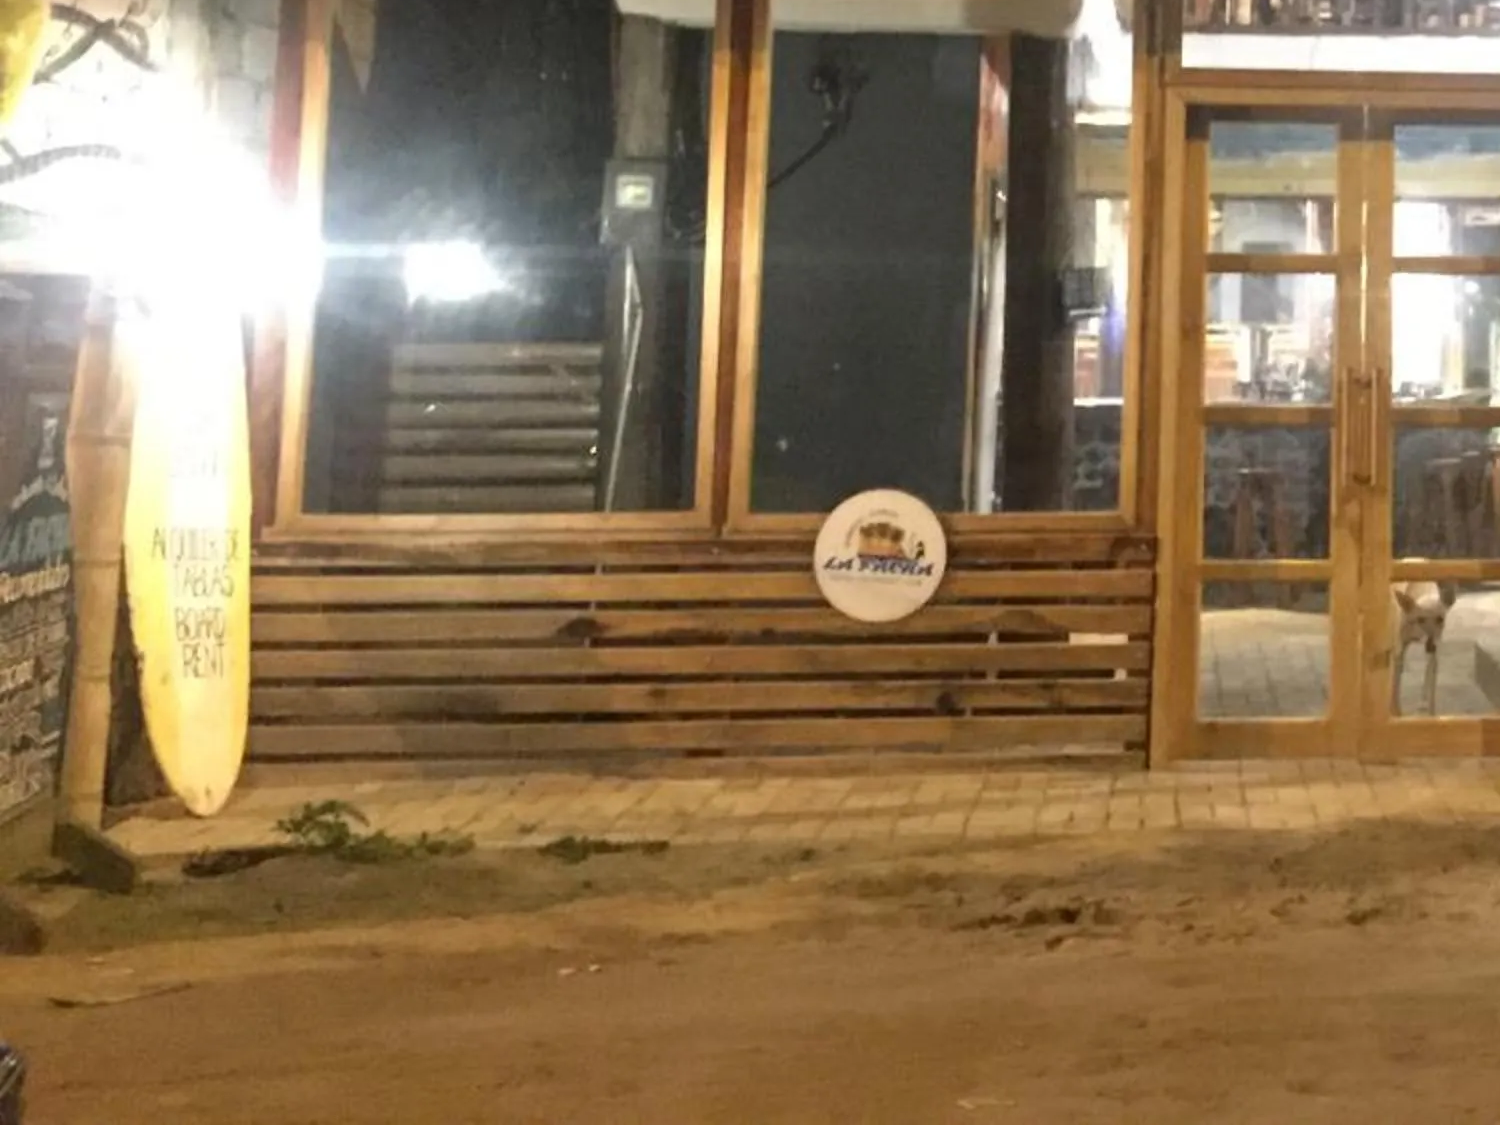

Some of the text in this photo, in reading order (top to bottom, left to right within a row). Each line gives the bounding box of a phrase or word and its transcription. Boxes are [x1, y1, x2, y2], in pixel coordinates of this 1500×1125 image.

[173, 563, 235, 598] TABLAS
[823, 556, 854, 571] LA
[174, 606, 226, 642] BOARD
[182, 641, 226, 679] RENT
